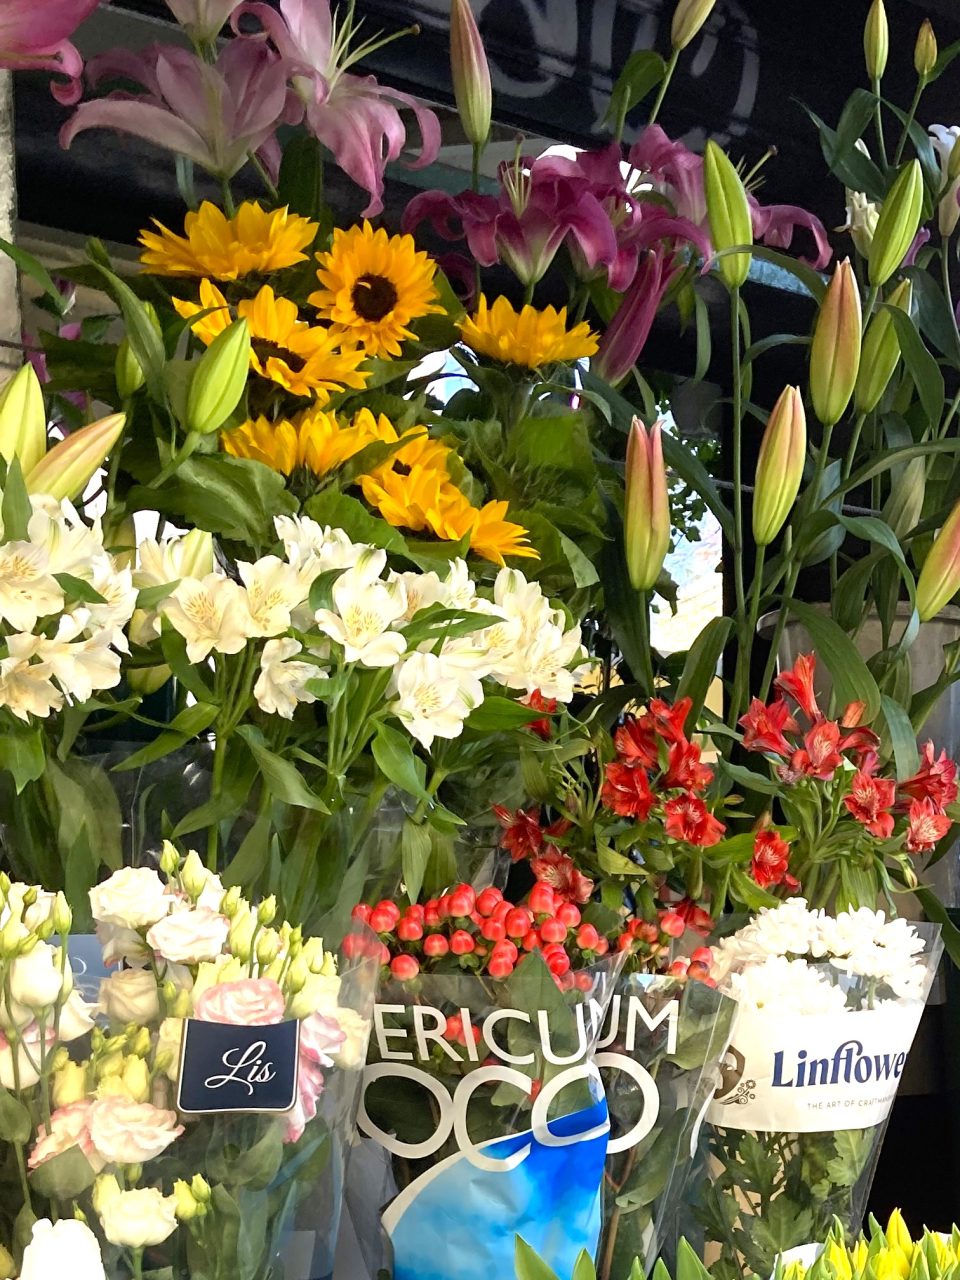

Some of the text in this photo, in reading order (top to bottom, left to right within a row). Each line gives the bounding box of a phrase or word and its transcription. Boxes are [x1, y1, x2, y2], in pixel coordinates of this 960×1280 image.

[204, 1041, 277, 1096] Lis
[808, 1102, 823, 1110] THE
[827, 1100, 841, 1109] ART
